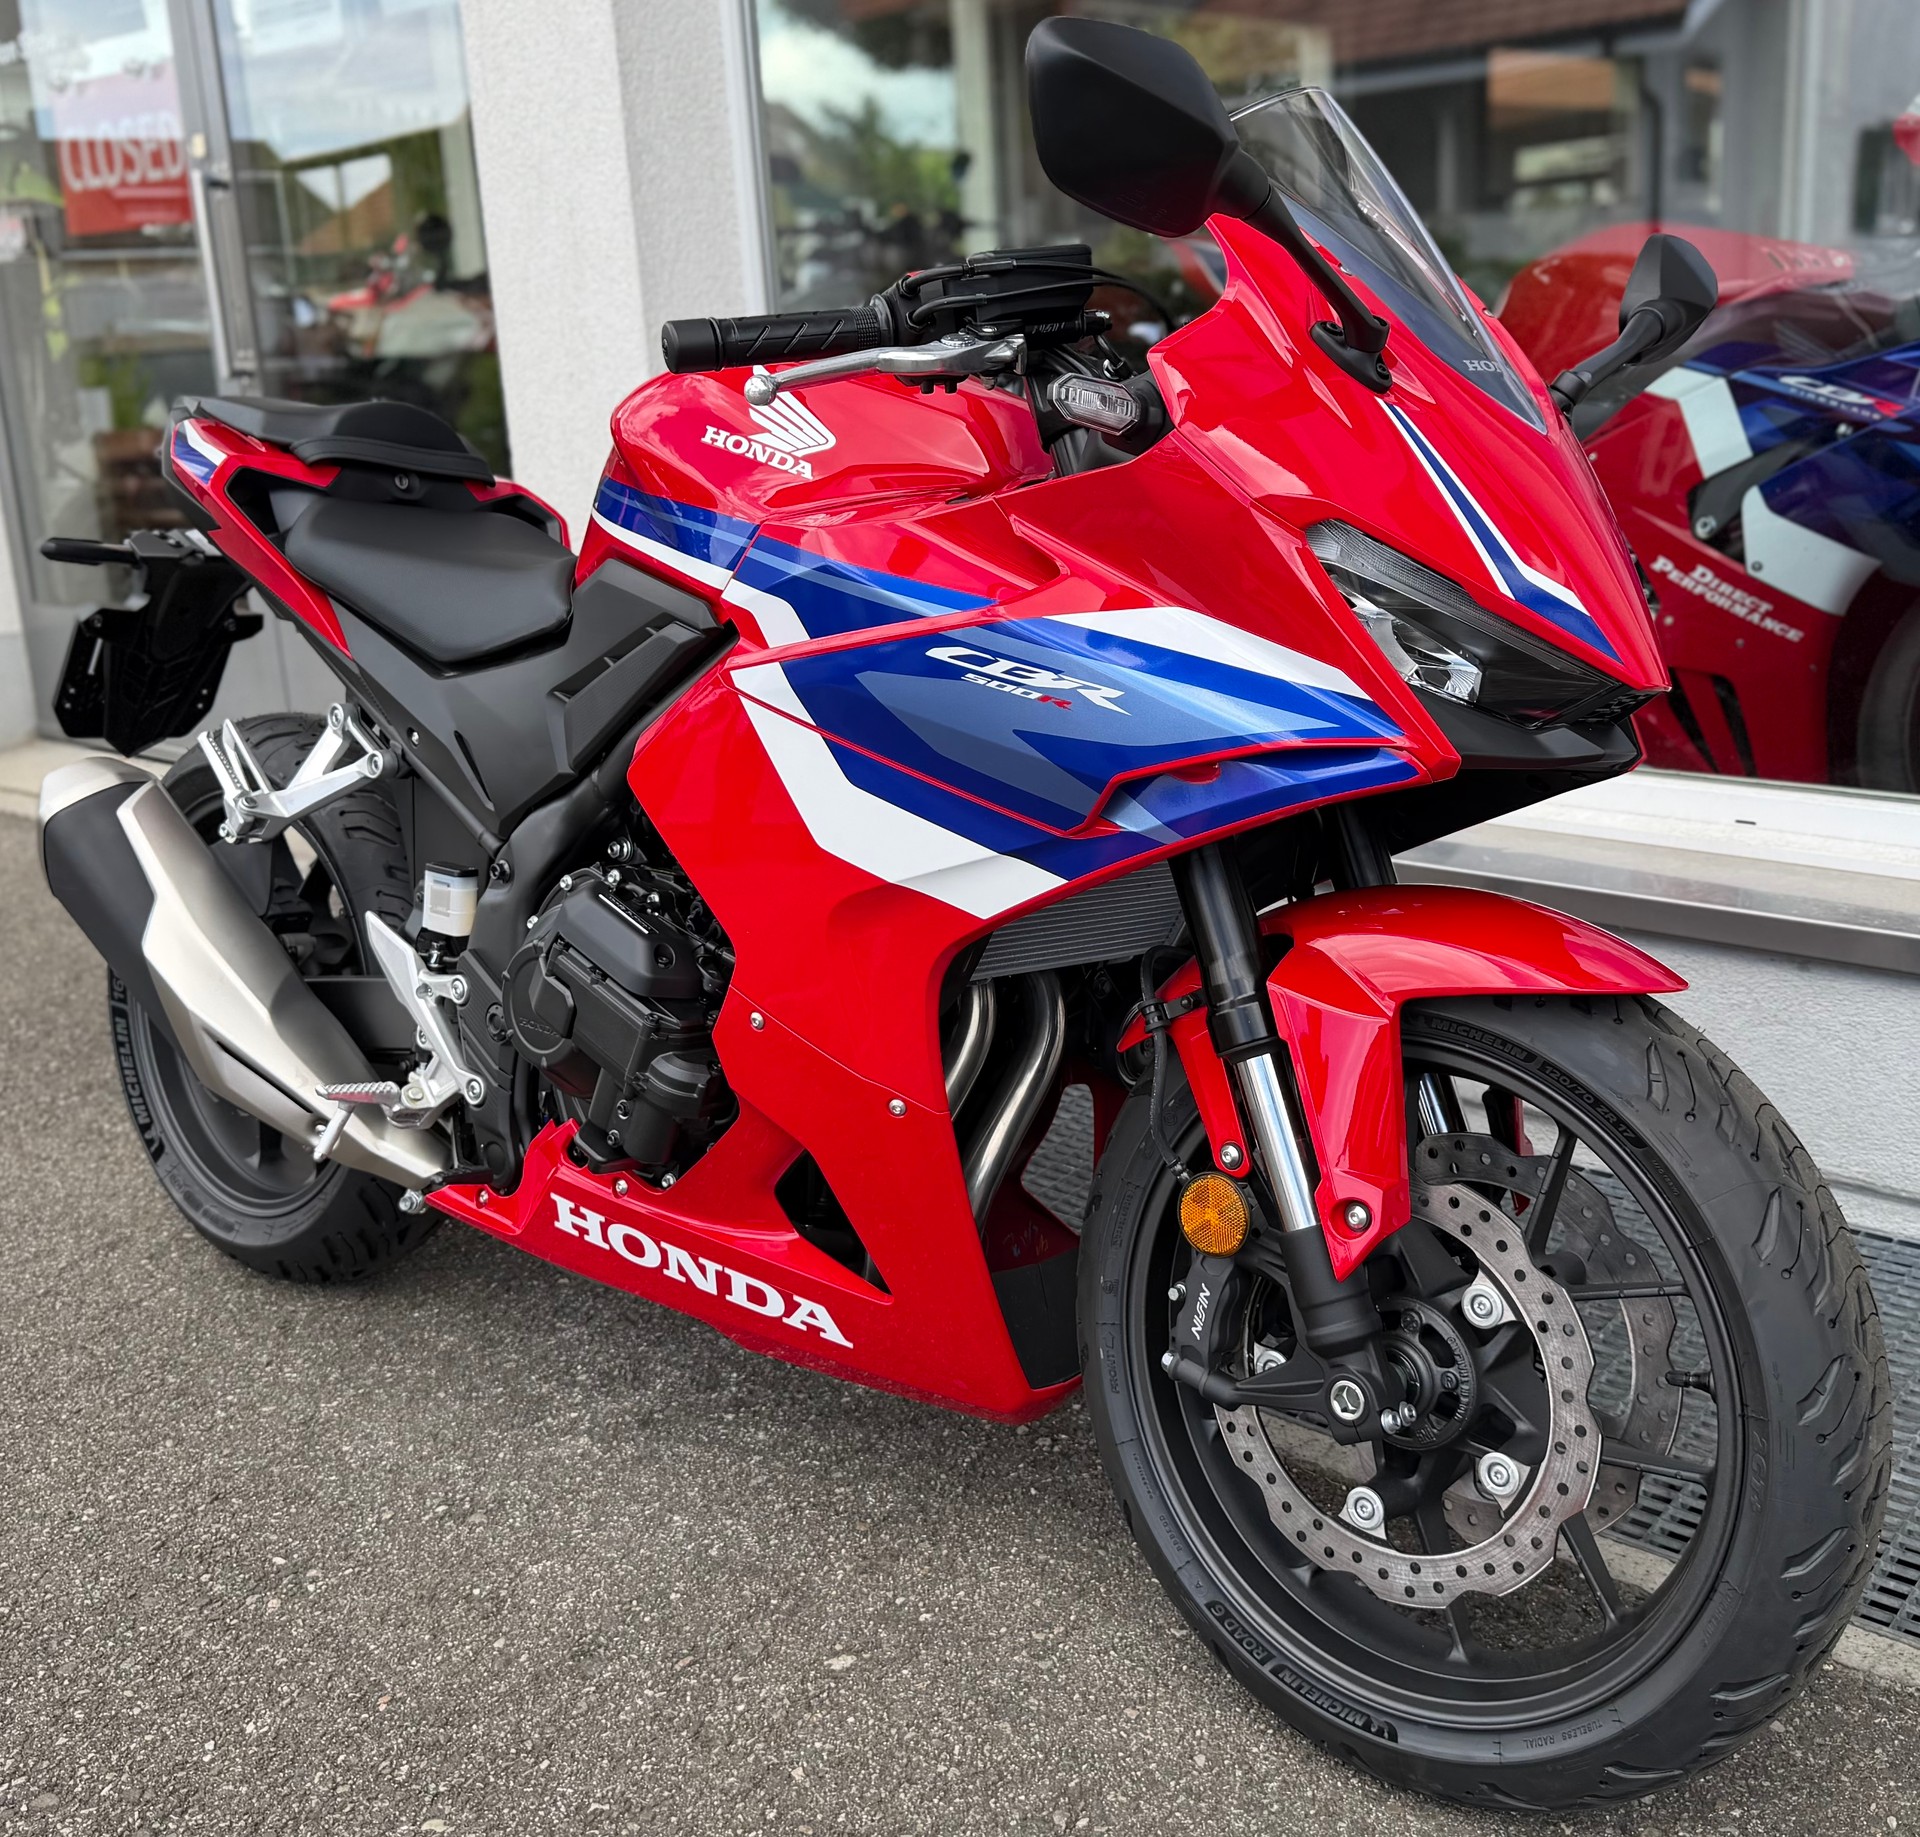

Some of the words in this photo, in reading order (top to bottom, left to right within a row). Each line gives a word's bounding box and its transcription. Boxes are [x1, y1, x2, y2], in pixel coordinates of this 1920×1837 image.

[57, 112, 186, 191] CLOSED
[700, 425, 813, 480] HONDA
[1650, 554, 1805, 643] PERFORMANCE
[1689, 564, 1774, 614] DIRECT
[925, 646, 1132, 716] CBR
[961, 673, 1073, 711] 500R
[115, 1017, 155, 1126] MICHELIN
[1431, 1018, 1528, 1060] MICHELIN
[1544, 1065, 1595, 1103] 120/70
[1596, 1102, 1618, 1124] ZR
[1617, 1122, 1638, 1138] 17
[550, 1191, 854, 1349] HONDA
[1211, 1603, 1226, 1617] 6
[1223, 1617, 1266, 1662] ROAD
[1277, 1669, 1370, 1727] MICHELIN
[1523, 1734, 1555, 1749] RADIAL
[1562, 1719, 1604, 1741] TUBELESS
